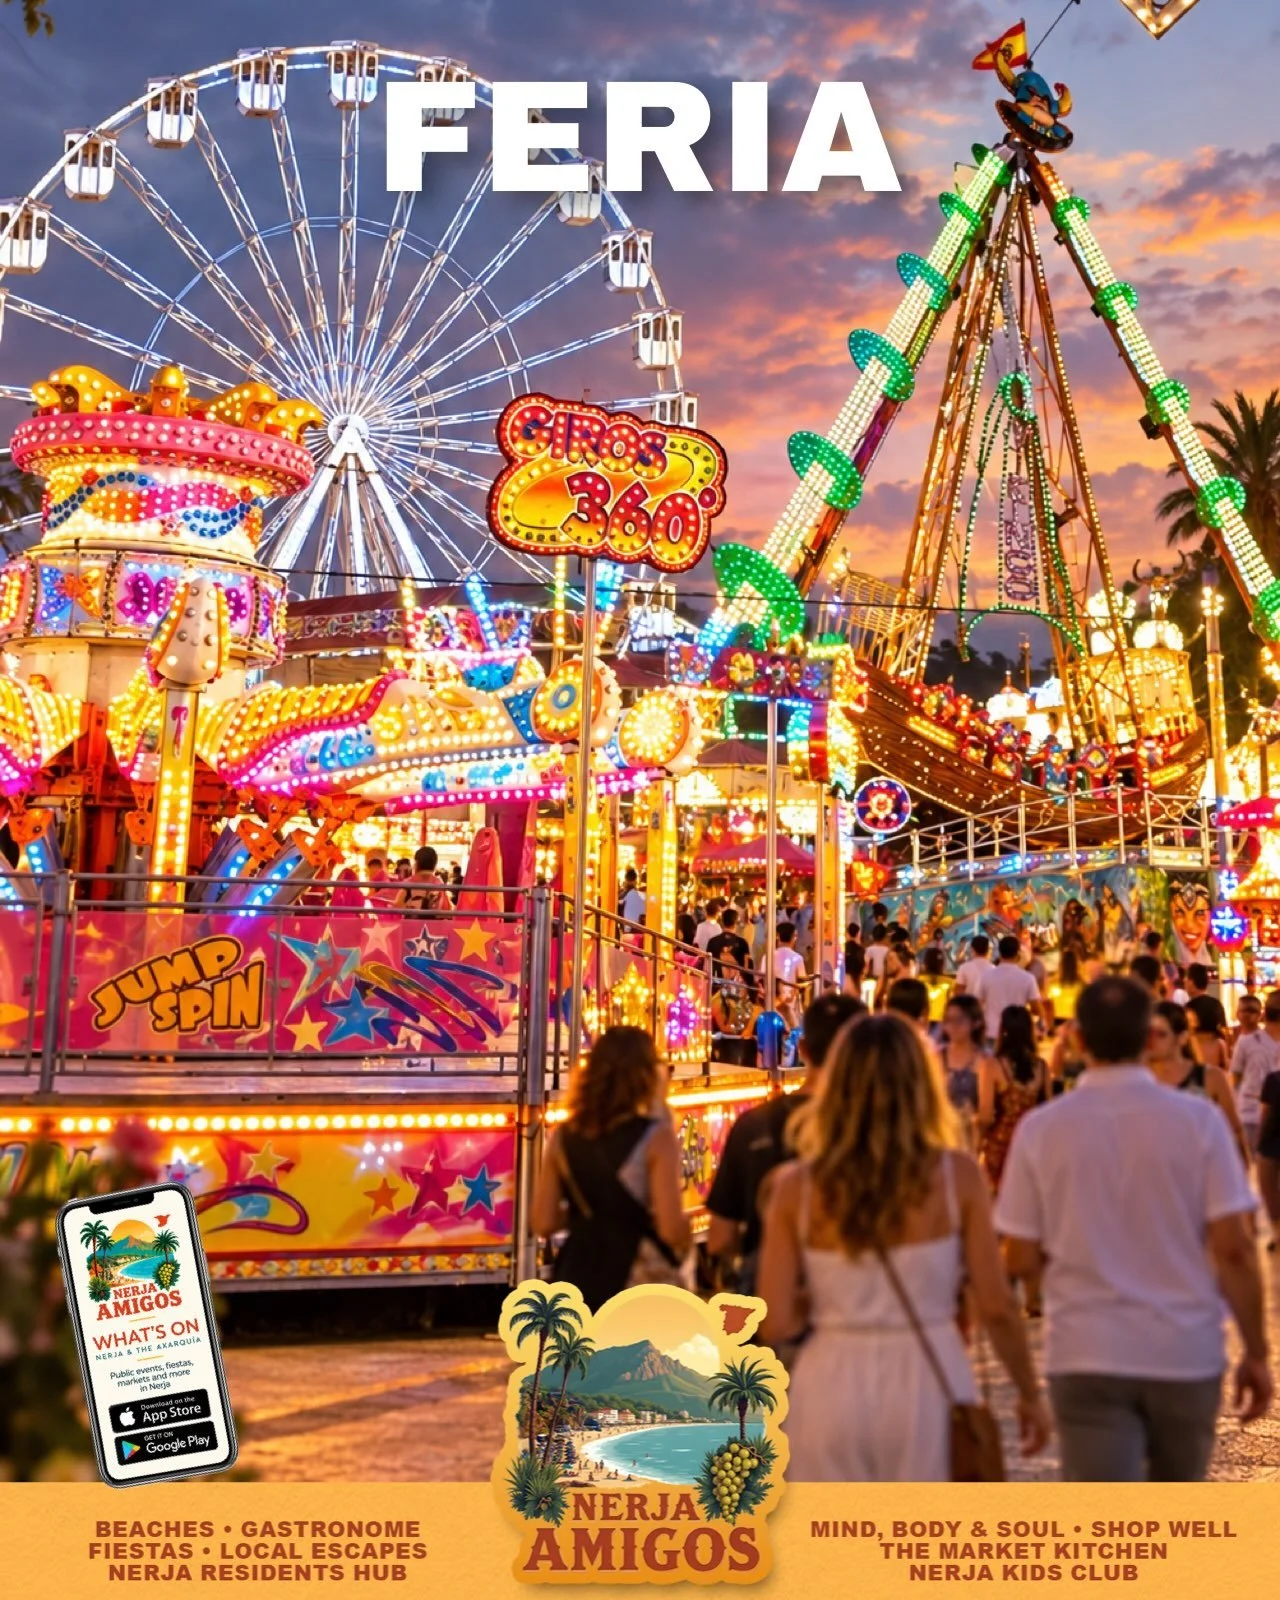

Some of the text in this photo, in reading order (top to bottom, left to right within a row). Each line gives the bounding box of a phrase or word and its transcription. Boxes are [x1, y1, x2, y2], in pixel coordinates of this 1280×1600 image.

[507, 405, 668, 480] GIROS
[90, 935, 242, 1030] JUMP
[151, 960, 265, 1033] SPIN
